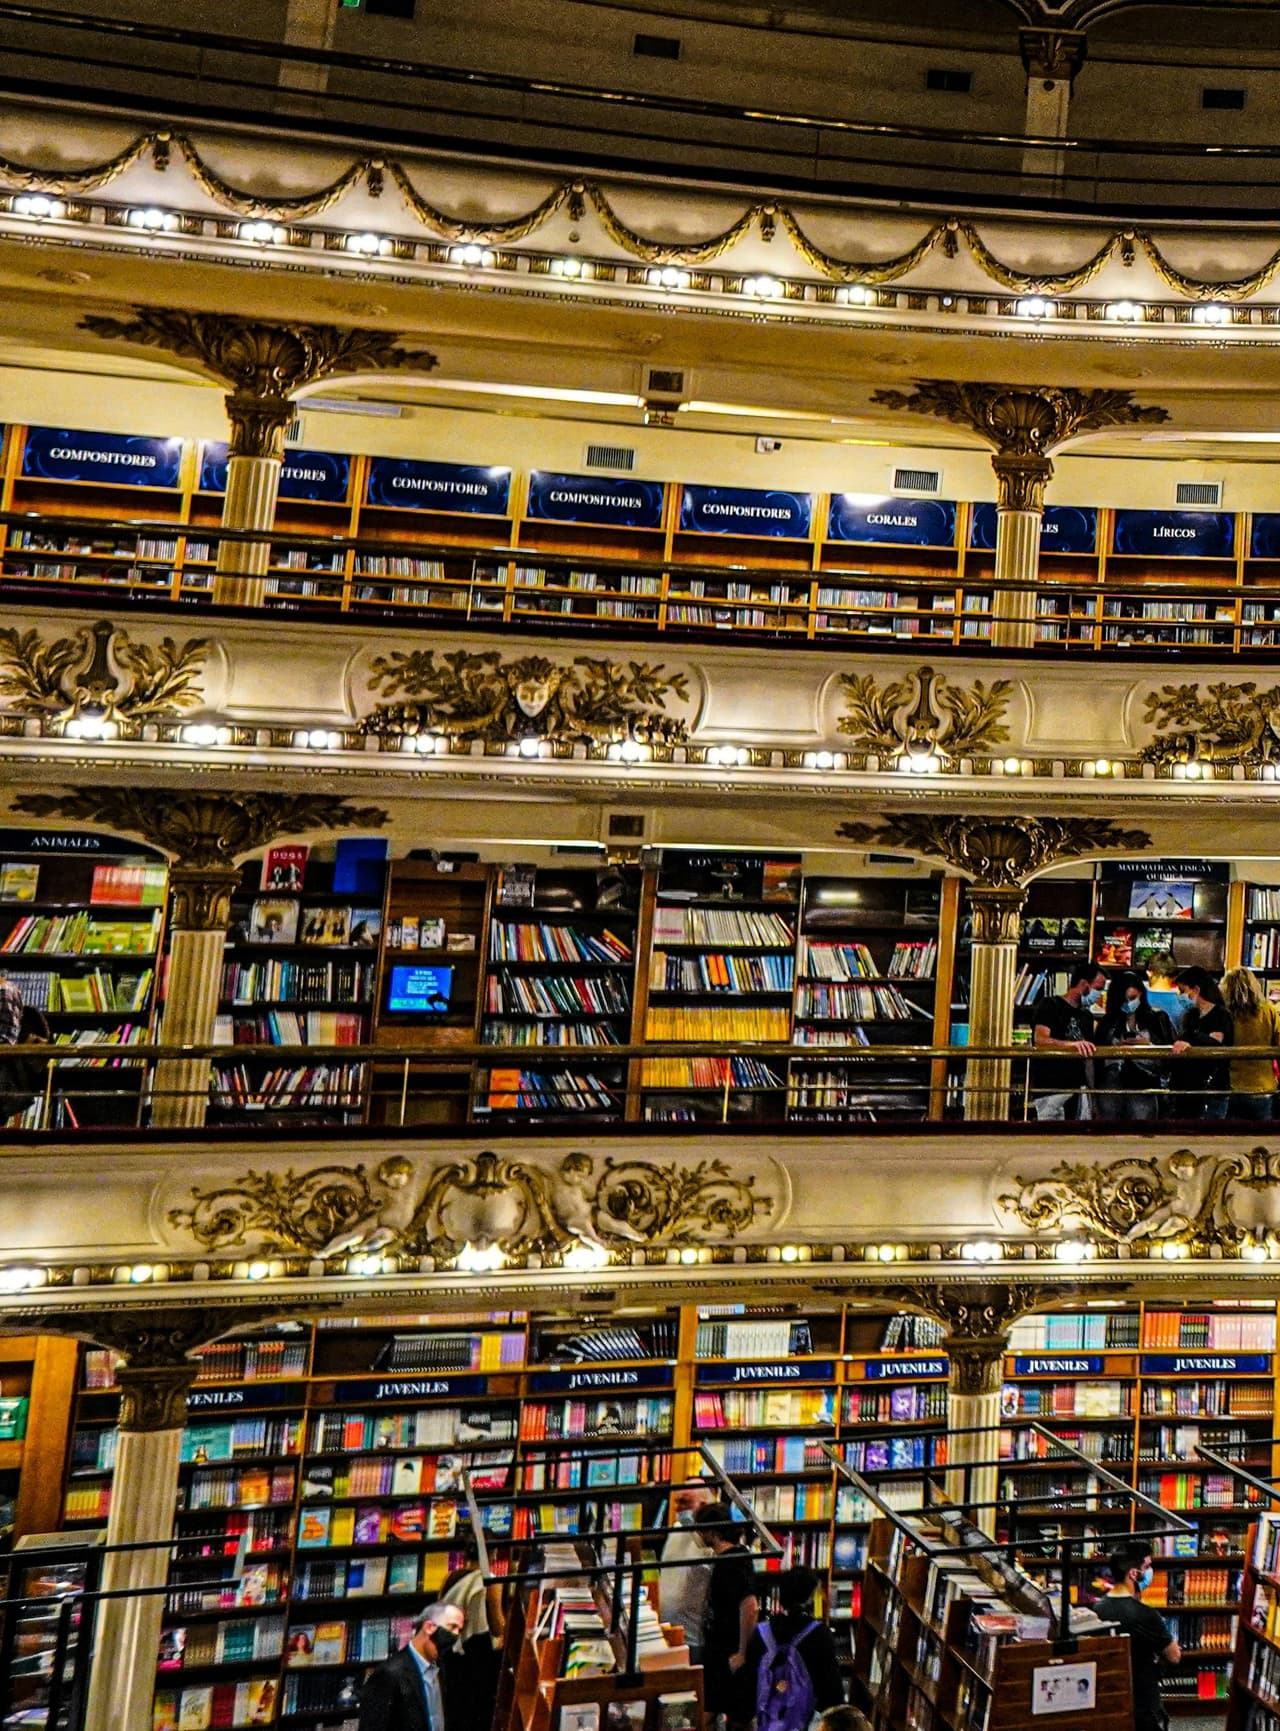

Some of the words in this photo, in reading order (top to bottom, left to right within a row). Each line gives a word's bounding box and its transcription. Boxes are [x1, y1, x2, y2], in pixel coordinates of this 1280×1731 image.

[50, 447, 157, 468] COMPOSITORES
[391, 476, 488, 497] COMPOSITORES
[550, 490, 642, 509] COMPOSITORES
[702, 503, 791, 520] COMPOSITORES
[866, 513, 917, 527] CORALES
[1153, 525, 1196, 539] LÍRICOS
[31, 836, 100, 849] ANIMALES
[734, 1365, 801, 1381] JUVENILES
[879, 1362, 943, 1377] JUVENILES
[1028, 1360, 1089, 1373] JUVENILES
[1174, 1358, 1236, 1372] JUVENILES
[569, 1371, 639, 1388] JUVENILES
[185, 1390, 244, 1406] VENILES
[376, 1381, 450, 1399] JUVENILES
